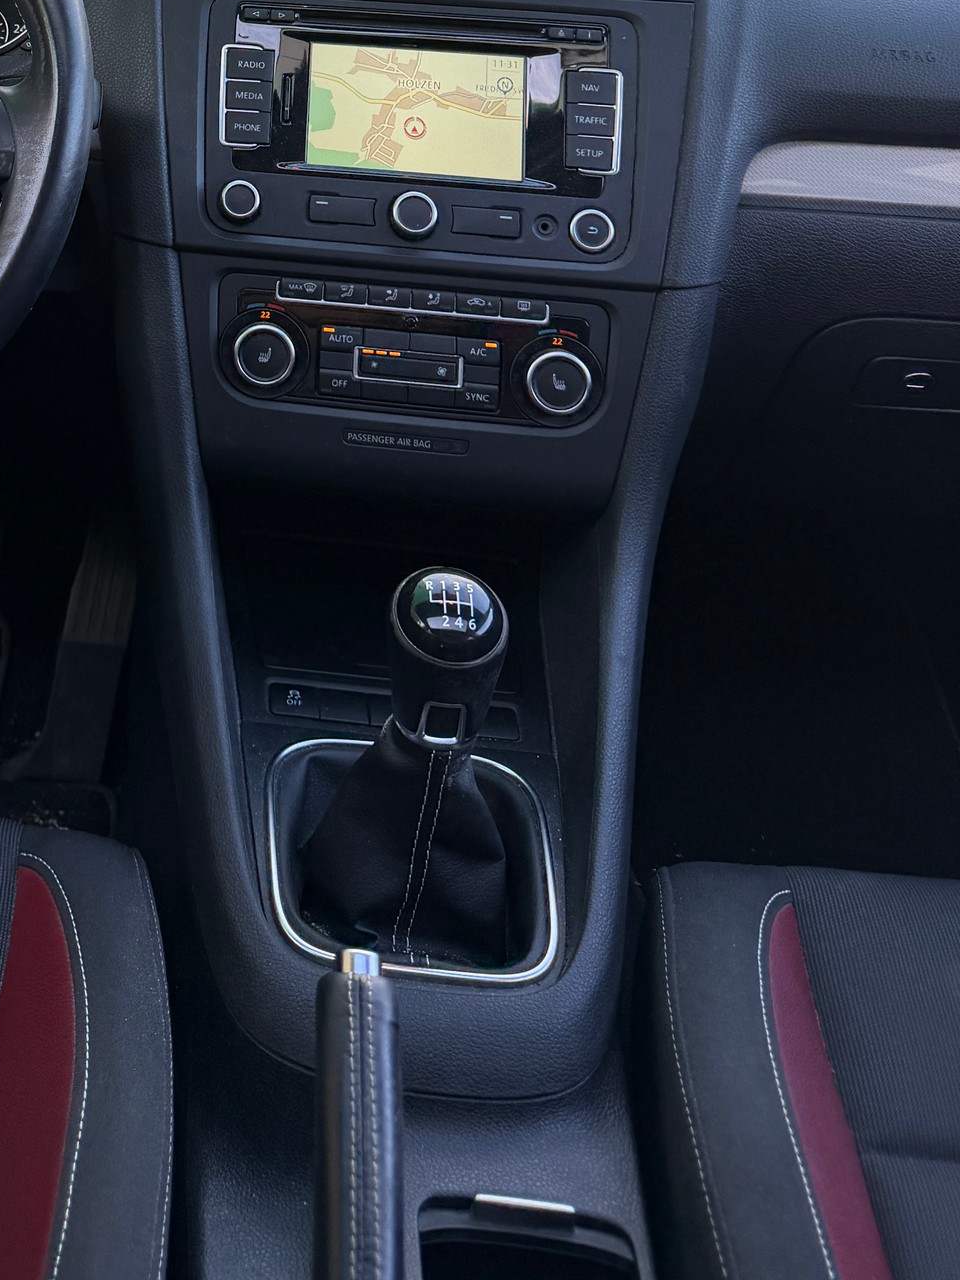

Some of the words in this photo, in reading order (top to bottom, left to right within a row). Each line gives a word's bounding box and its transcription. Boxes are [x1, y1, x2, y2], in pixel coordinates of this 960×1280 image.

[238, 60, 266, 70] RADIO
[398, 79, 441, 90] HOLZEN
[501, 81, 509, 90] N
[581, 83, 601, 93] NAV
[235, 91, 264, 101] MEDIA
[574, 115, 608, 126] TRAFFIC
[234, 123, 261, 132] PHONE
[575, 148, 604, 158] SETUP
[288, 283, 303, 291] MAX
[260, 311, 271, 319] 22
[328, 333, 354, 343] AUTO
[552, 337, 563, 346] 22
[469, 347, 487, 357] A/C
[331, 379, 348, 388] OFF
[465, 392, 490, 403] SYNC
[347, 432, 395, 445] PASSENGER
[396, 437, 411, 447] AIR
[413, 439, 431, 449] BAG
[426, 580, 434, 590] R
[440, 580, 445, 590] 1
[453, 582, 461, 591] 3
[467, 583, 474, 593] 5
[442, 616, 450, 627] 2
[454, 617, 464, 628] 4
[468, 619, 477, 630] 6
[286, 698, 303, 707] OFF
